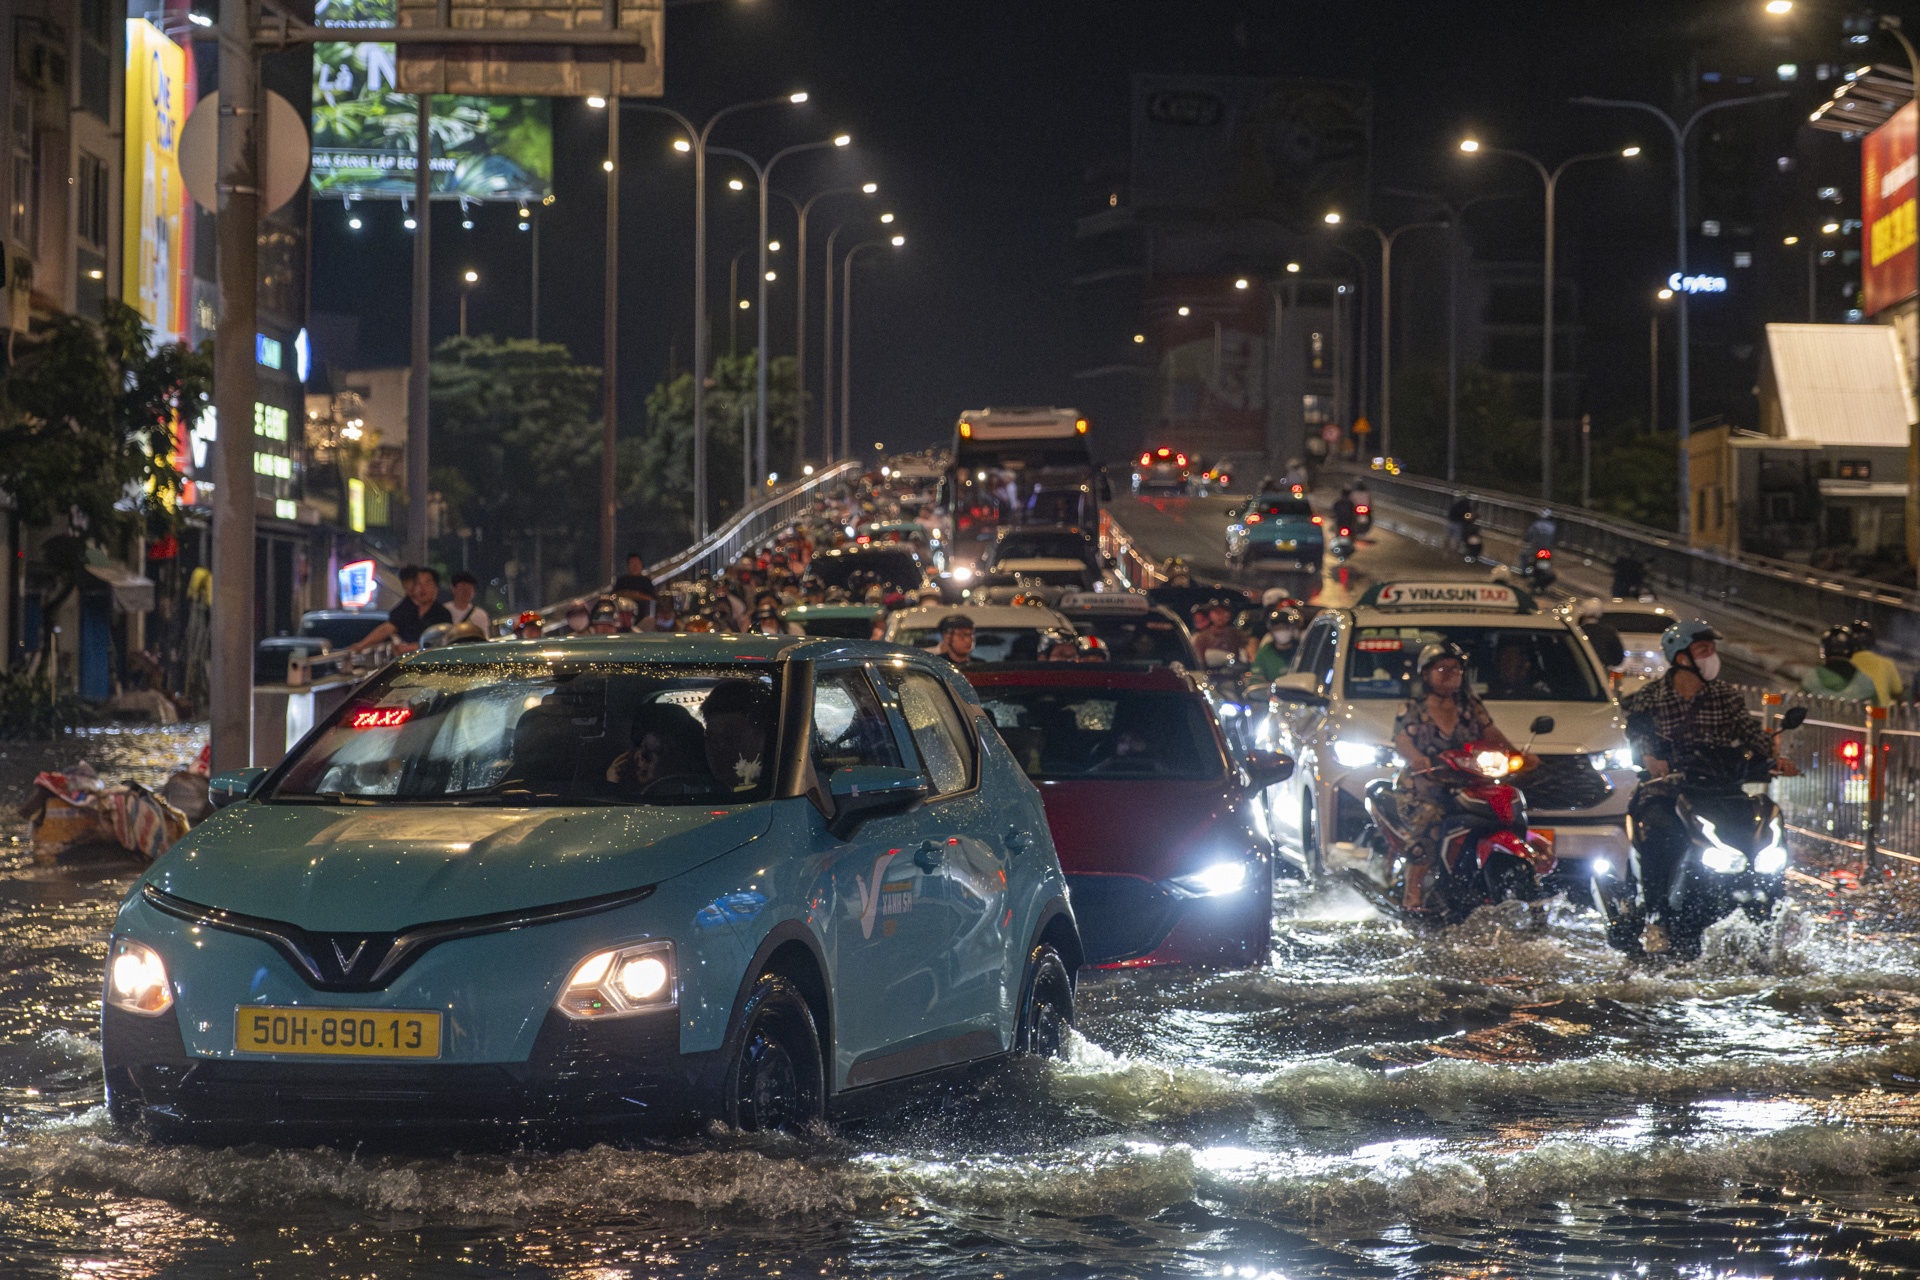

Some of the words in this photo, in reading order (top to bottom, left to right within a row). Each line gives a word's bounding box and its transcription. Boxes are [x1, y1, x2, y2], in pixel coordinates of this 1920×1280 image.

[1408, 588, 1477, 601] VINASUN
[1479, 589, 1509, 602] TAXI
[253, 1015, 422, 1049] 50H-890.13
